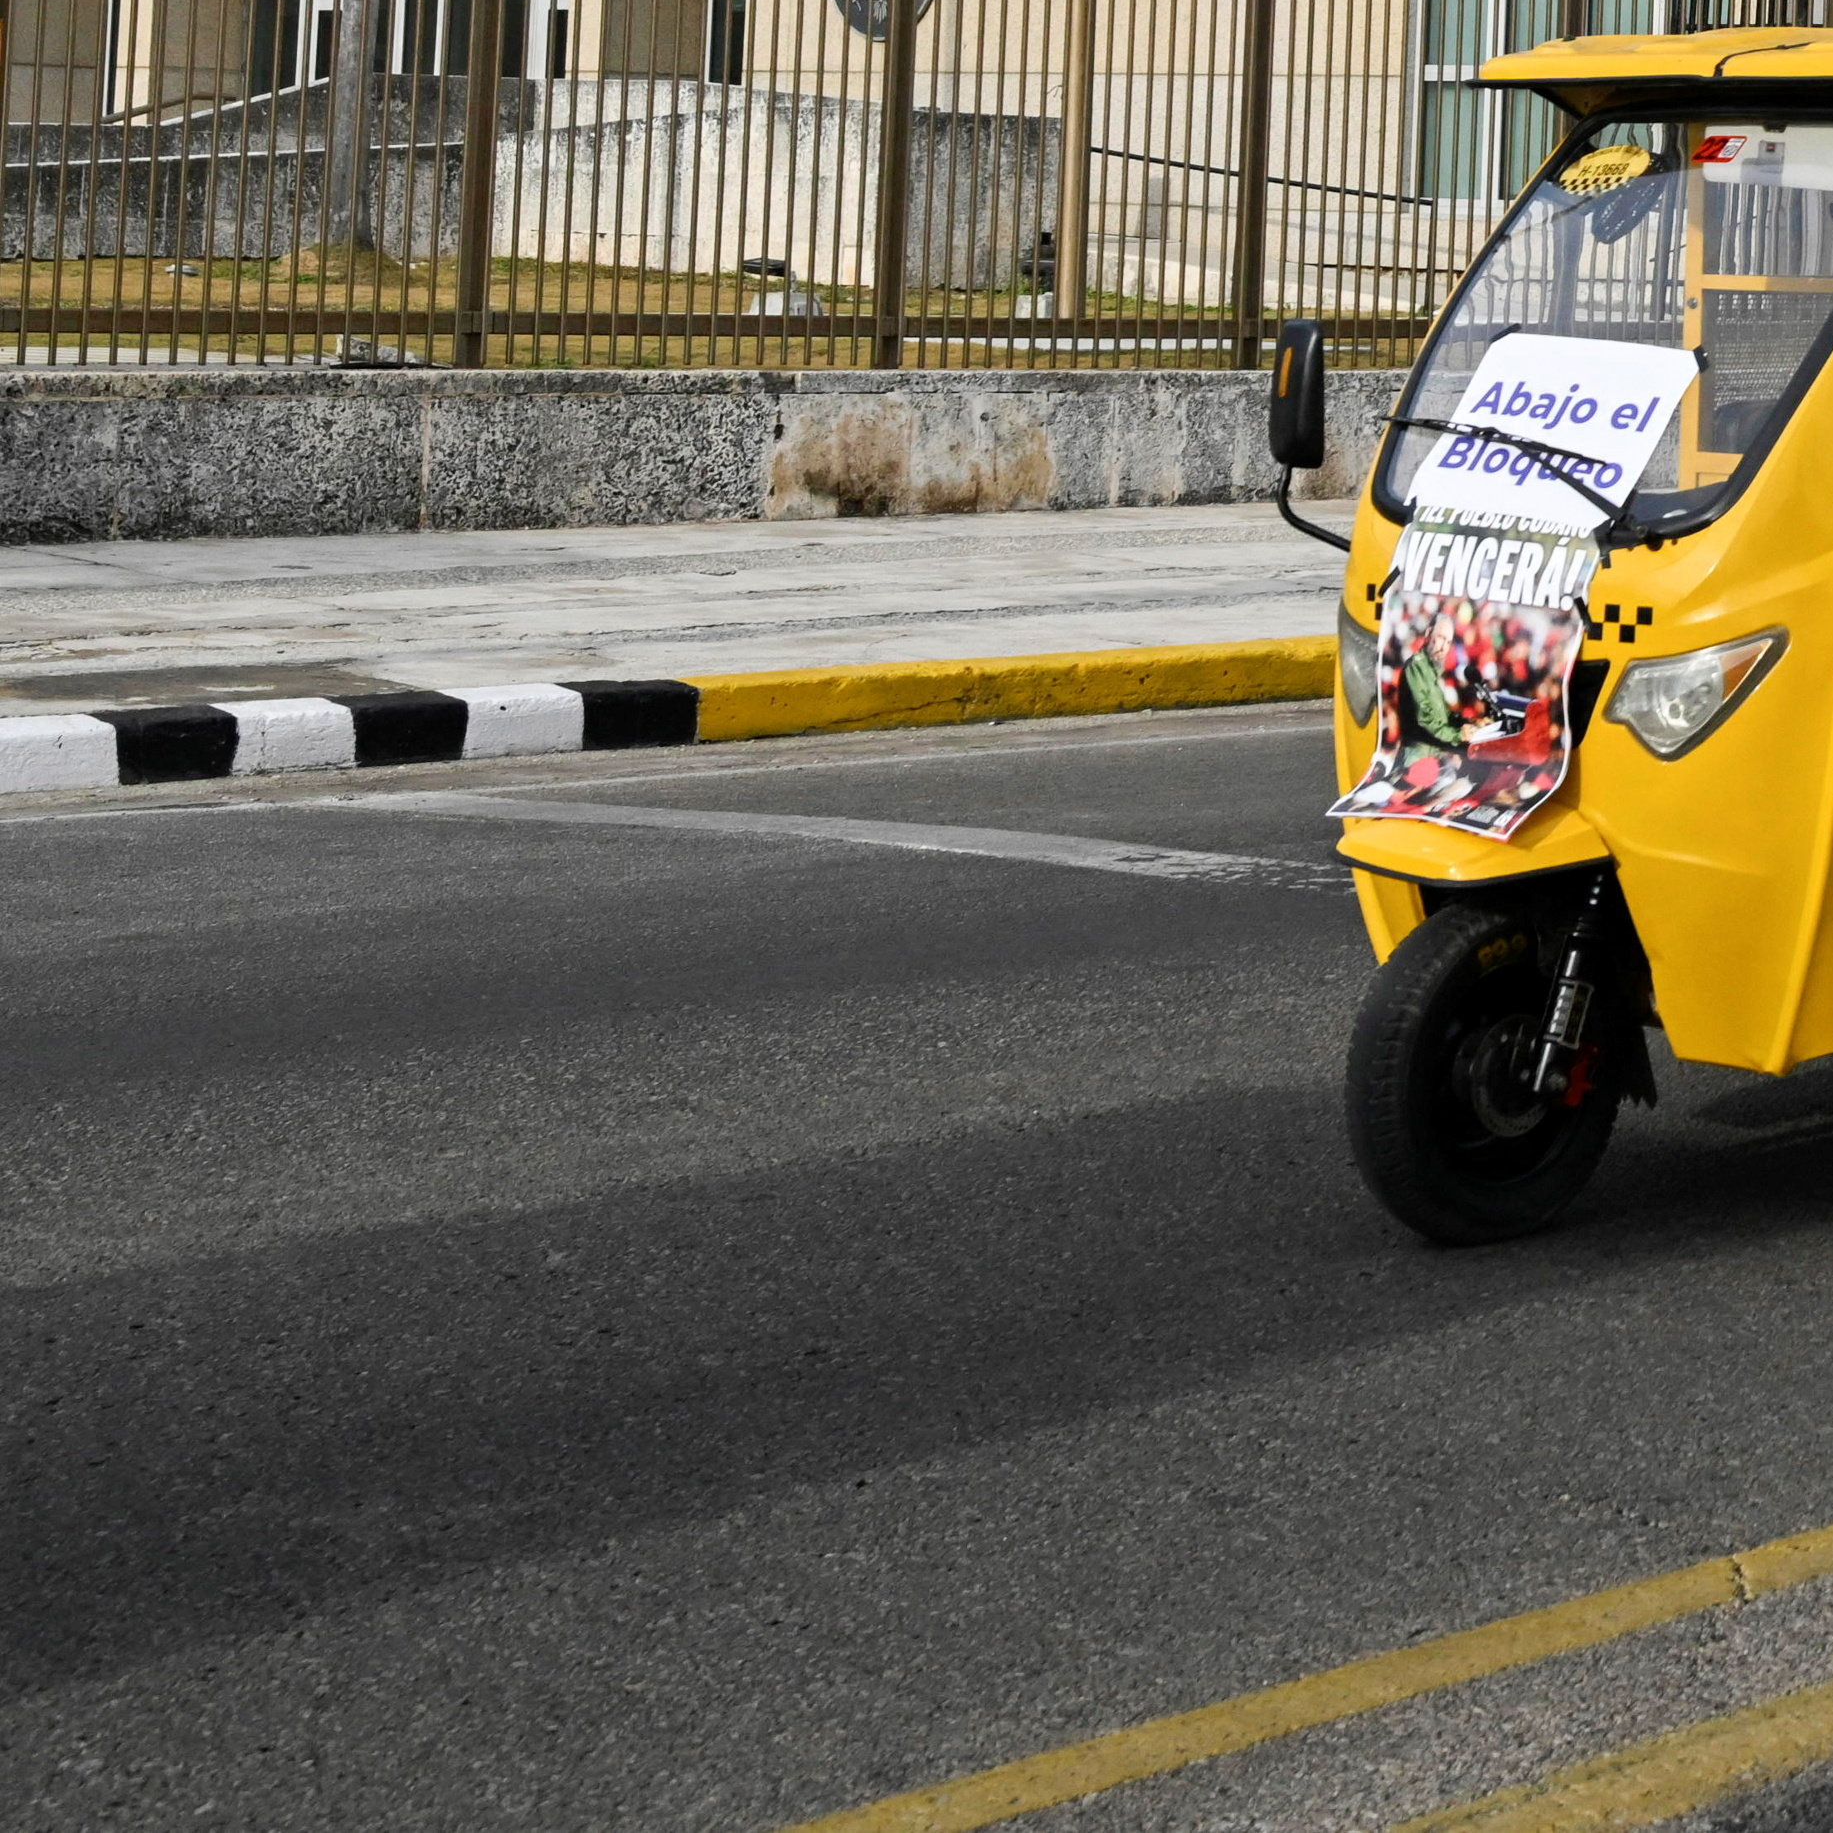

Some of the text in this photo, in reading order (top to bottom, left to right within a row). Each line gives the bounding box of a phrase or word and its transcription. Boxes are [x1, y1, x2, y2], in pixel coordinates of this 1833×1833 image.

[1470, 381, 1661, 433] Abajo el
[1403, 530, 1588, 612] VENCERÁ!
